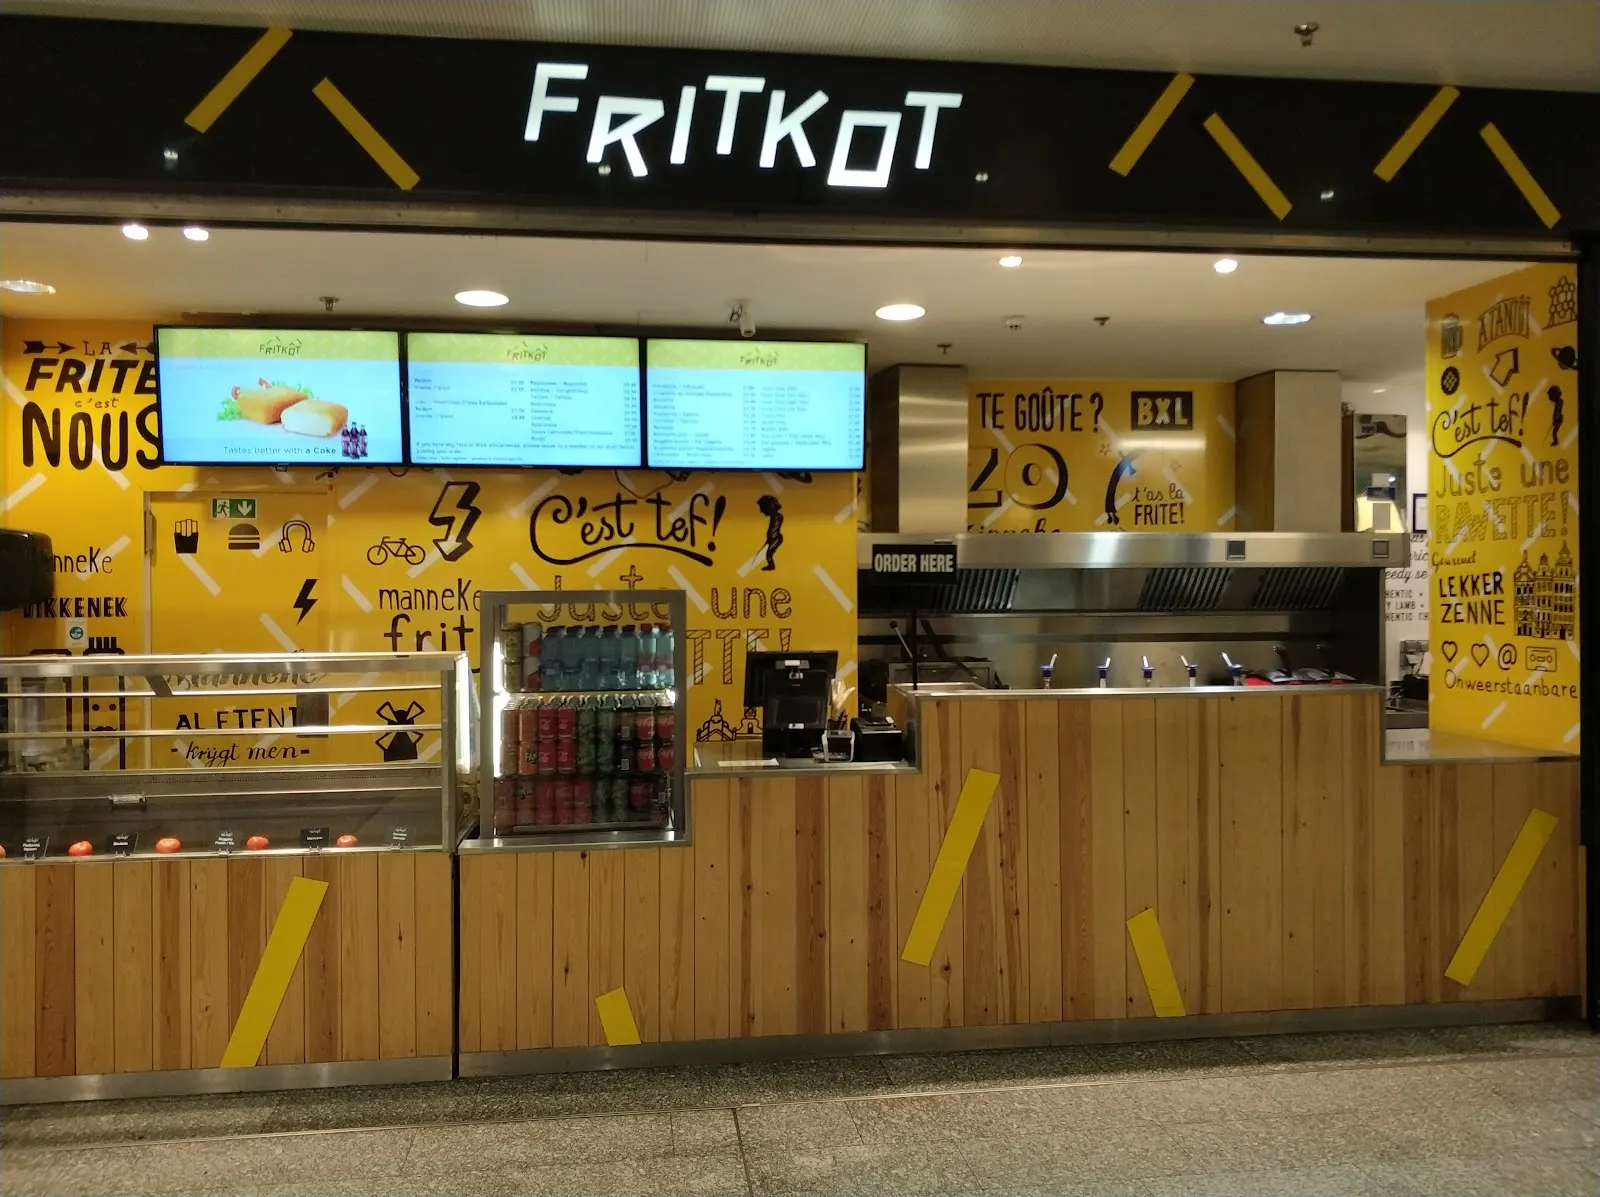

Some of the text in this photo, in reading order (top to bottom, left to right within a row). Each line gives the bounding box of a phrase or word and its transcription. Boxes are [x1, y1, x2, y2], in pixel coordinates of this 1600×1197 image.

[524, 62, 963, 188] FRITKOT
[83, 340, 112, 356] LA
[25, 358, 157, 394] FRITE
[75, 398, 119, 409] c'est
[976, 393, 1004, 429] TE
[1137, 397, 1188, 426] BXL
[22, 401, 161, 472] NOUS
[223, 446, 252, 455] Tastes
[254, 446, 281, 455] better
[284, 446, 303, 455] with
[313, 446, 337, 455] Coke
[1436, 453, 1570, 498] Juste une
[1134, 503, 1185, 525] FRITE!
[874, 553, 954, 573] ORDER HERE
[1439, 571, 1505, 598] LEKKER
[711, 588, 792, 619] une
[1441, 600, 1506, 625] ZENNE
[1444, 668, 1578, 699] Onweerstaanbare
